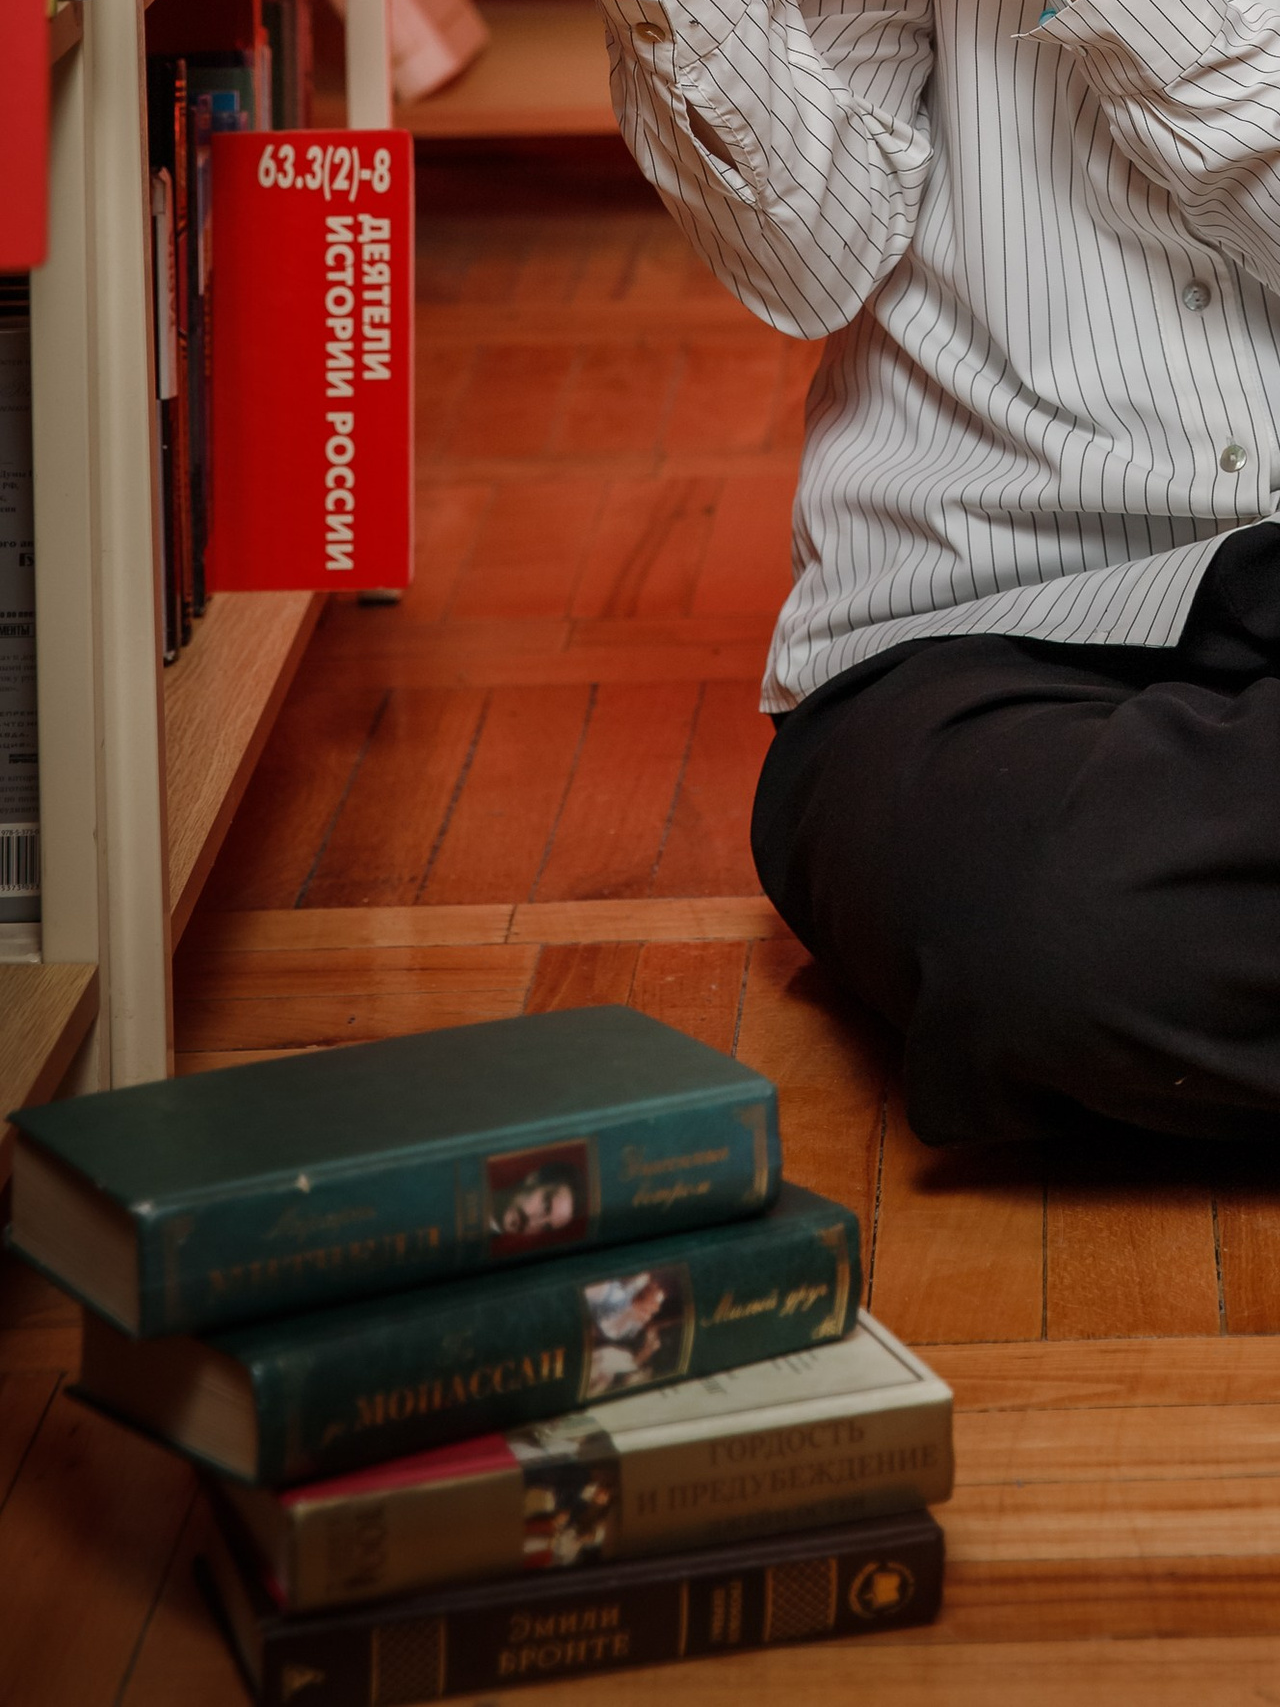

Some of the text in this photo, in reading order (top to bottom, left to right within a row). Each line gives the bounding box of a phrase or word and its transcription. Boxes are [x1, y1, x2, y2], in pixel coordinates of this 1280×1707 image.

[259, 144, 391, 202] 63.3(2)-8
[358, 213, 391, 380] ДЕЯТЕЛИ
[325, 215, 355, 570] ИСТОРИИ РОССИИ
[0, 624, 30, 636] МЕНТЫ
[708, 1415, 865, 1468] ГОРДОСТЬ
[638, 1443, 938, 1518] И ПРЕДУБЕЖДЕНИЕ
[508, 1602, 621, 1642] Эмили
[499, 1630, 631, 1677] БРОНТЕ
